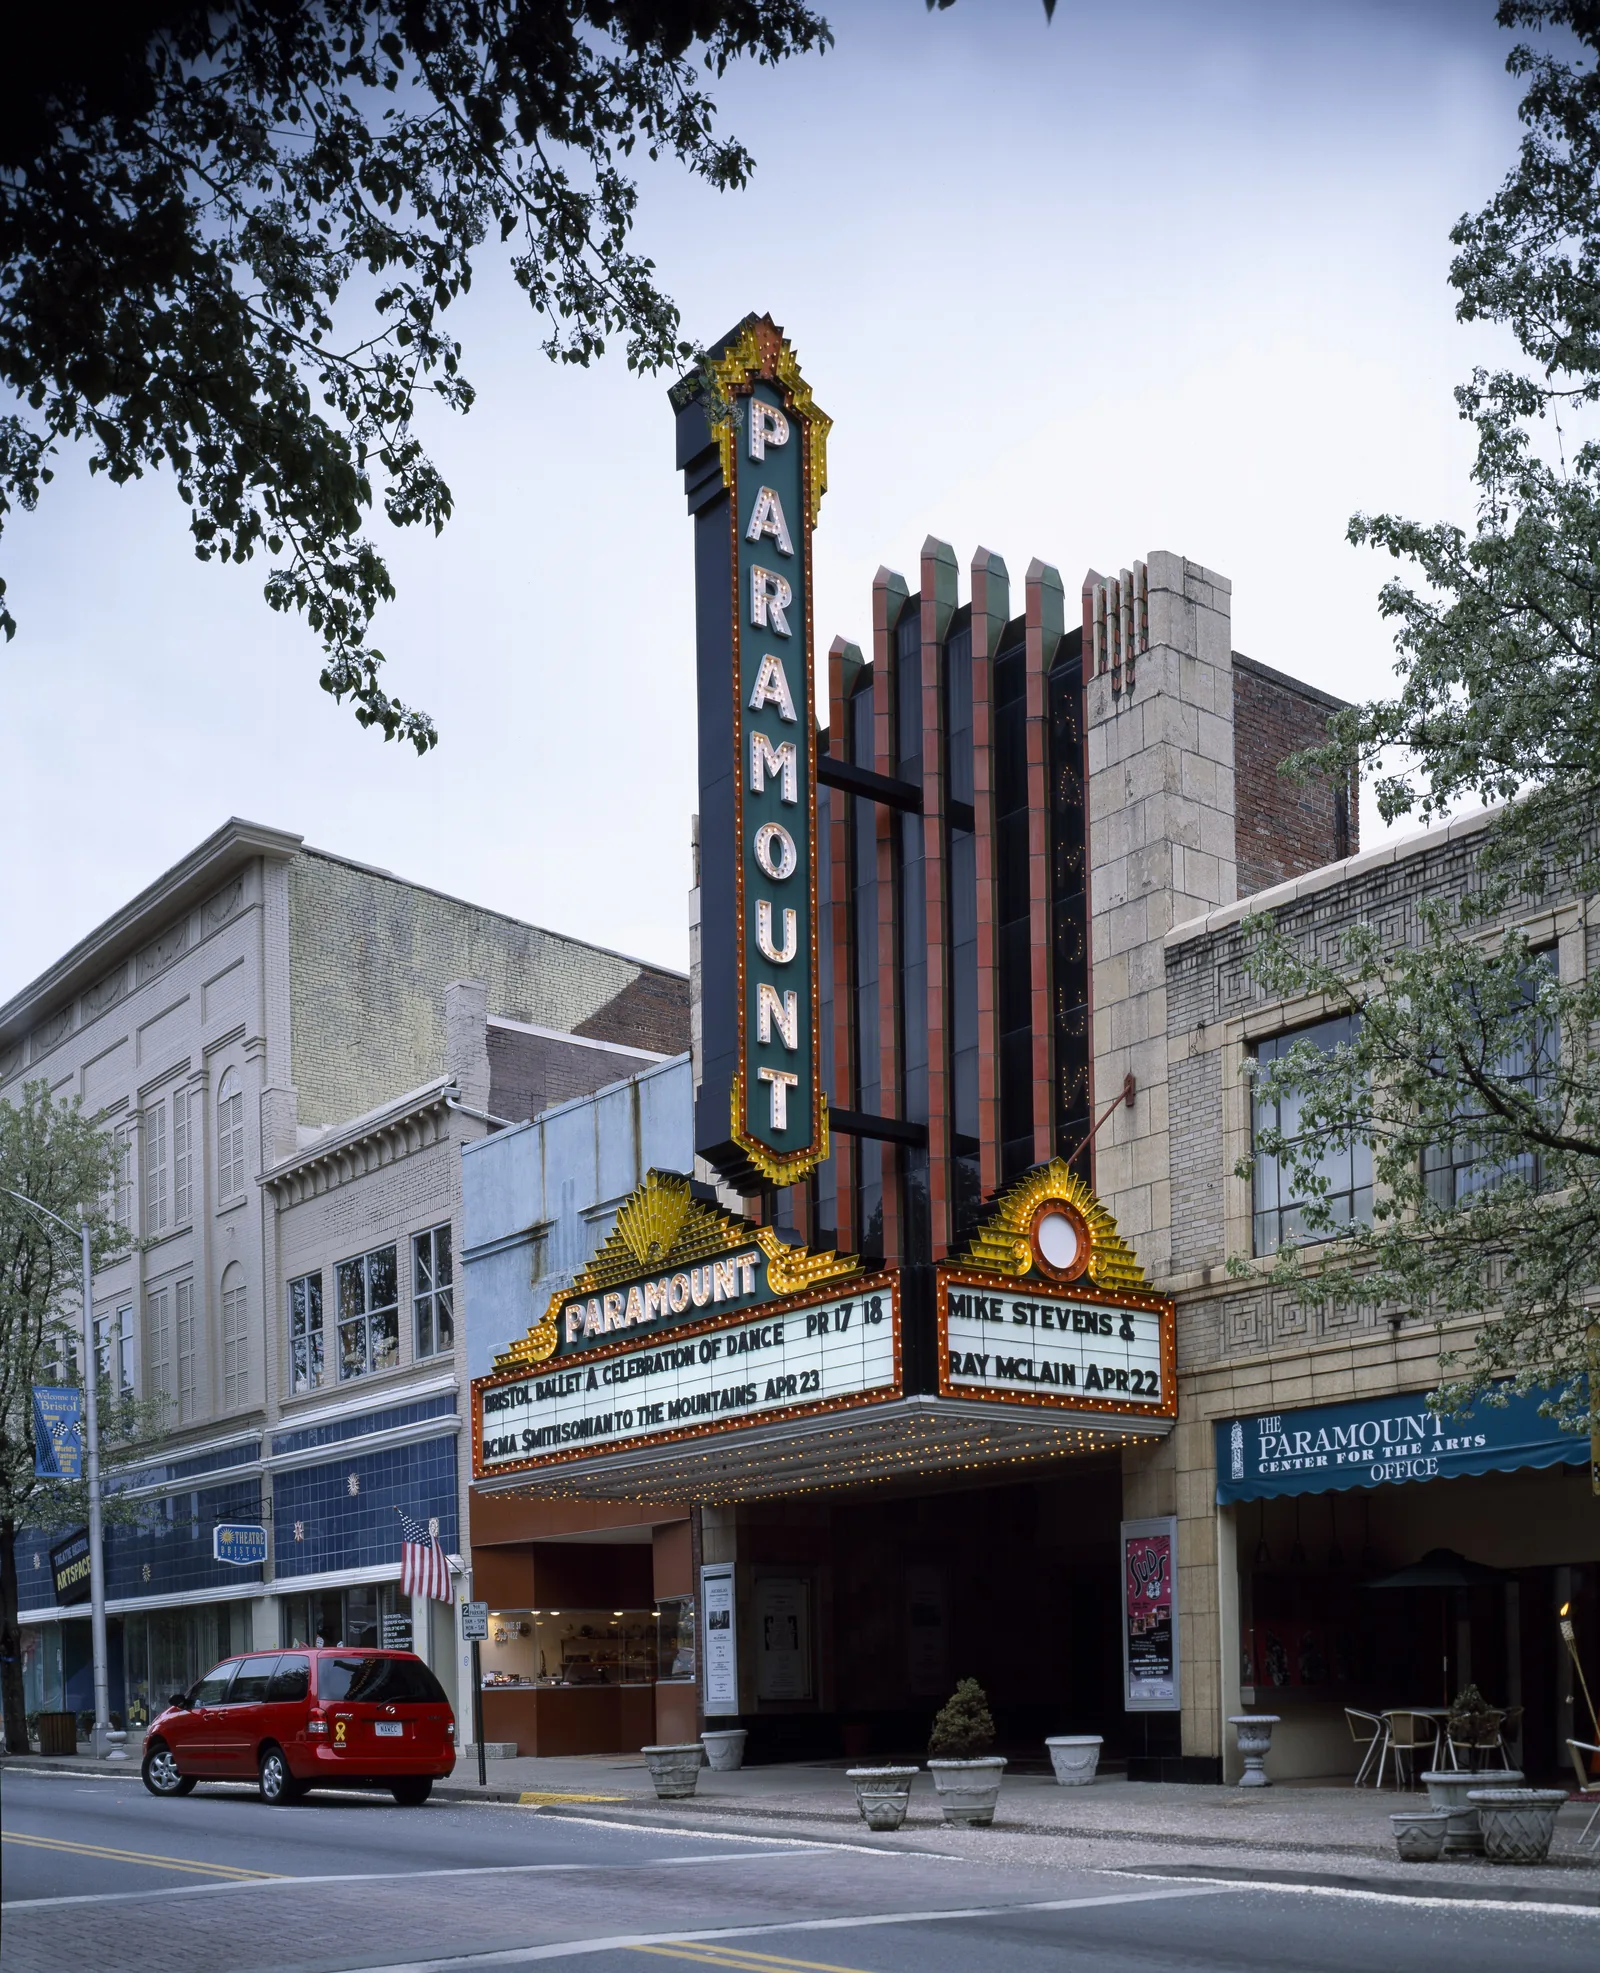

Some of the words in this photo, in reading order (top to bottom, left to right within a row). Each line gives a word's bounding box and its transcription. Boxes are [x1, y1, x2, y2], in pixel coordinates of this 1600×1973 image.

[746, 397, 798, 1130] PARAMOUNT
[565, 1251, 760, 1343] PARAMOUNT
[948, 1292, 1004, 1322] MIKE
[1012, 1301, 1113, 1335] STEVENS
[1119, 1313, 1136, 1341] &
[485, 1385, 532, 1413] BRISTOL
[536, 1372, 581, 1401] BALLET
[586, 1367, 598, 1391] A
[603, 1344, 695, 1384] CELEBRATION
[699, 1338, 722, 1364] OF
[727, 1322, 784, 1356] DANCE
[806, 1311, 829, 1338] PR
[834, 1302, 854, 1332] 17
[864, 1296, 883, 1324] 18
[948, 1350, 990, 1377] RAY
[995, 1355, 1075, 1386] MCLAIN
[35, 1392, 69, 1401] Welcome
[41, 1400, 77, 1411] Bristol
[483, 1434, 517, 1459] BCMA
[522, 1413, 613, 1451] SMITHSONIAN
[614, 1409, 633, 1431] TO
[637, 1403, 664, 1426] THE
[668, 1382, 758, 1420] MOUNTAINS
[765, 1374, 798, 1401] APR
[800, 1369, 820, 1395] 23
[1257, 1415, 1282, 1435] THE
[1258, 1411, 1450, 1460] PARAMOUNT
[1258, 1455, 1328, 1473] CENTER
[1336, 1449, 1375, 1464] FOR
[1382, 1442, 1422, 1459] THE
[1431, 1434, 1486, 1452] ARTS
[1370, 1457, 1439, 1482] OFFICE
[221, 1546, 263, 1554] BRISTOL
[235, 1531, 264, 1545] THEATRE
[57, 1555, 91, 1591] ARTSPACE
[463, 1605, 469, 1615] 2
